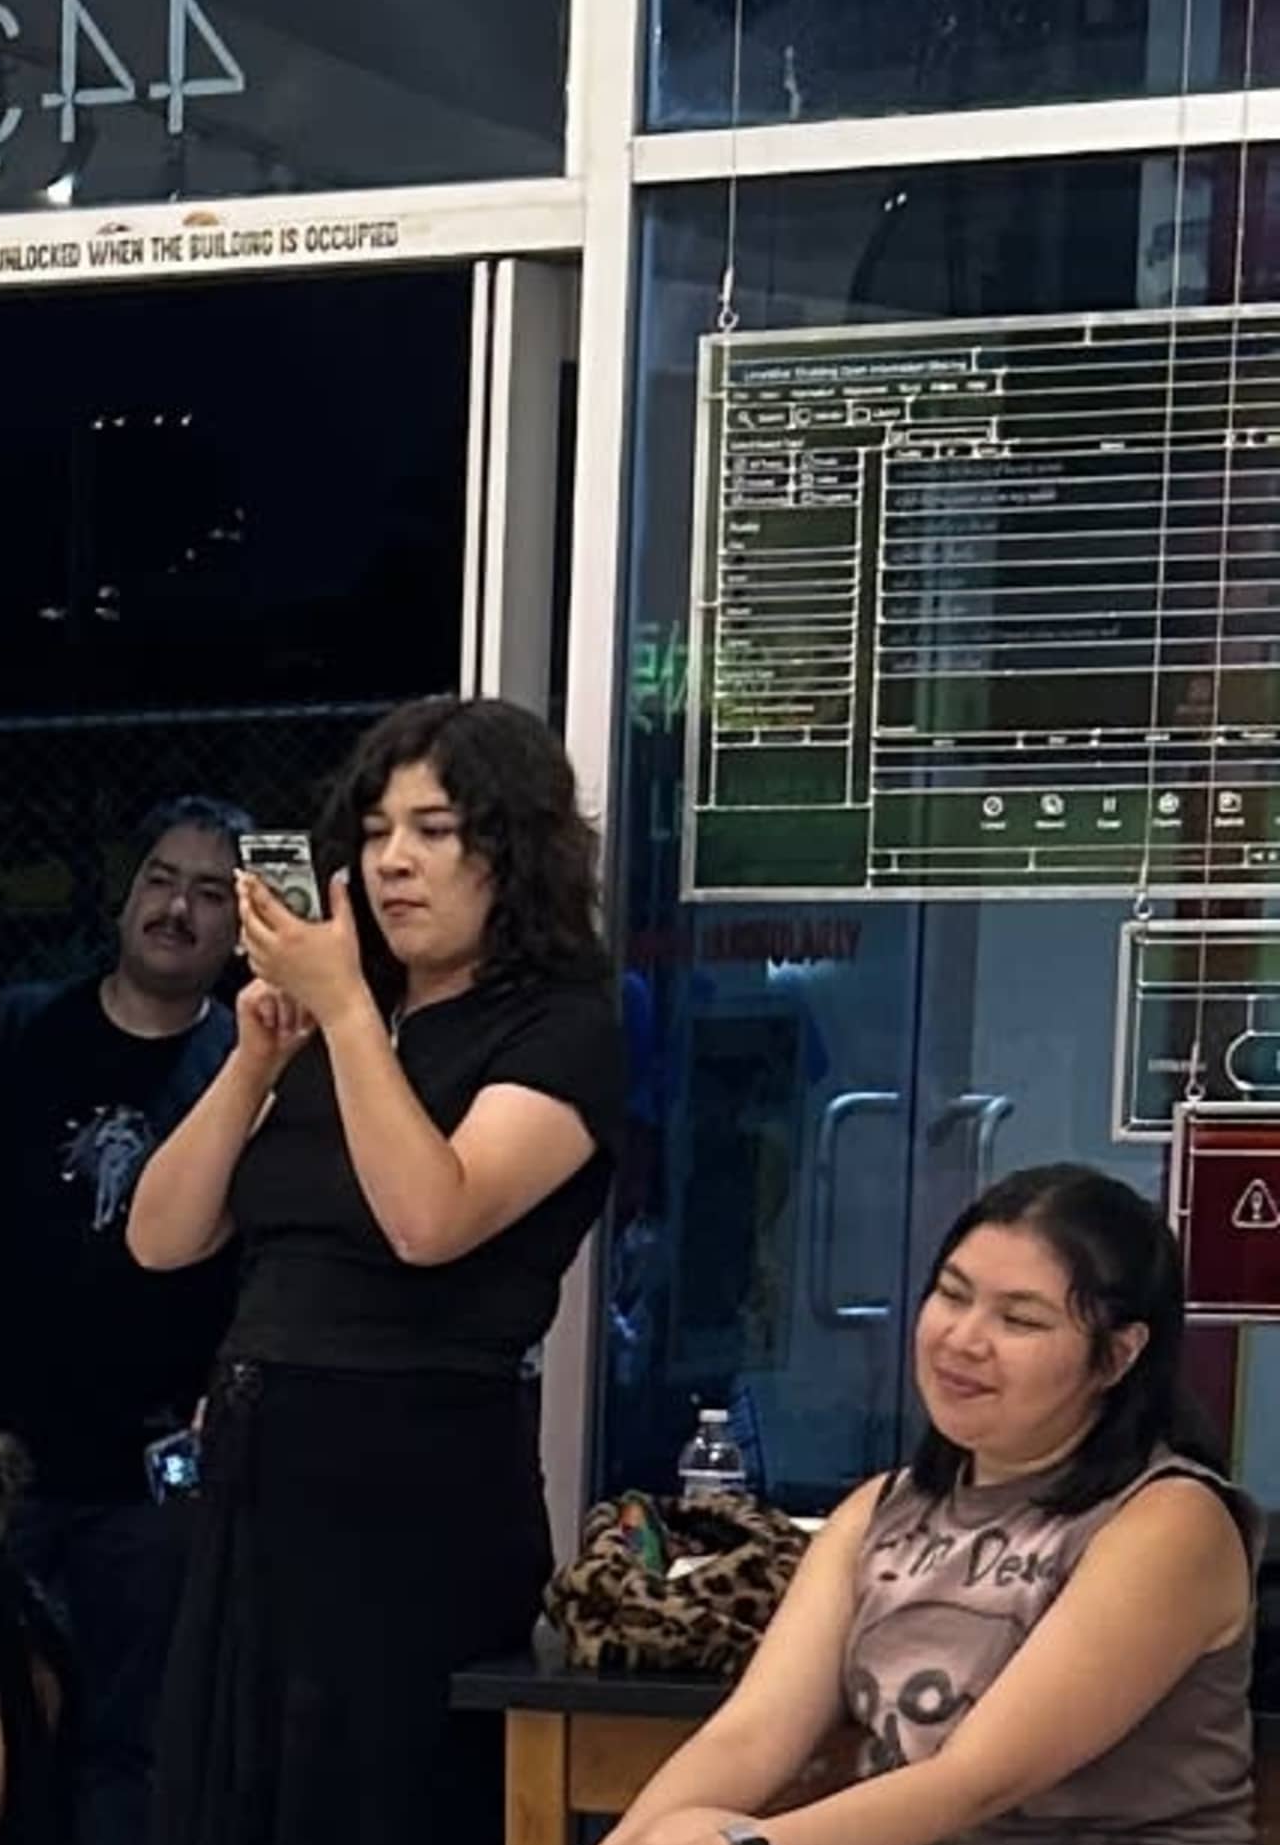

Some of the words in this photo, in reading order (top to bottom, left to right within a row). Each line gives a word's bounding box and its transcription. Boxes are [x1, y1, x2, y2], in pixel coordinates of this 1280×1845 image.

[89, 237, 144, 266] WHEN
[151, 234, 182, 262] THE
[191, 229, 273, 260] BUILDING
[280, 227, 298, 253] IS
[305, 221, 399, 253] OCCUPIED
